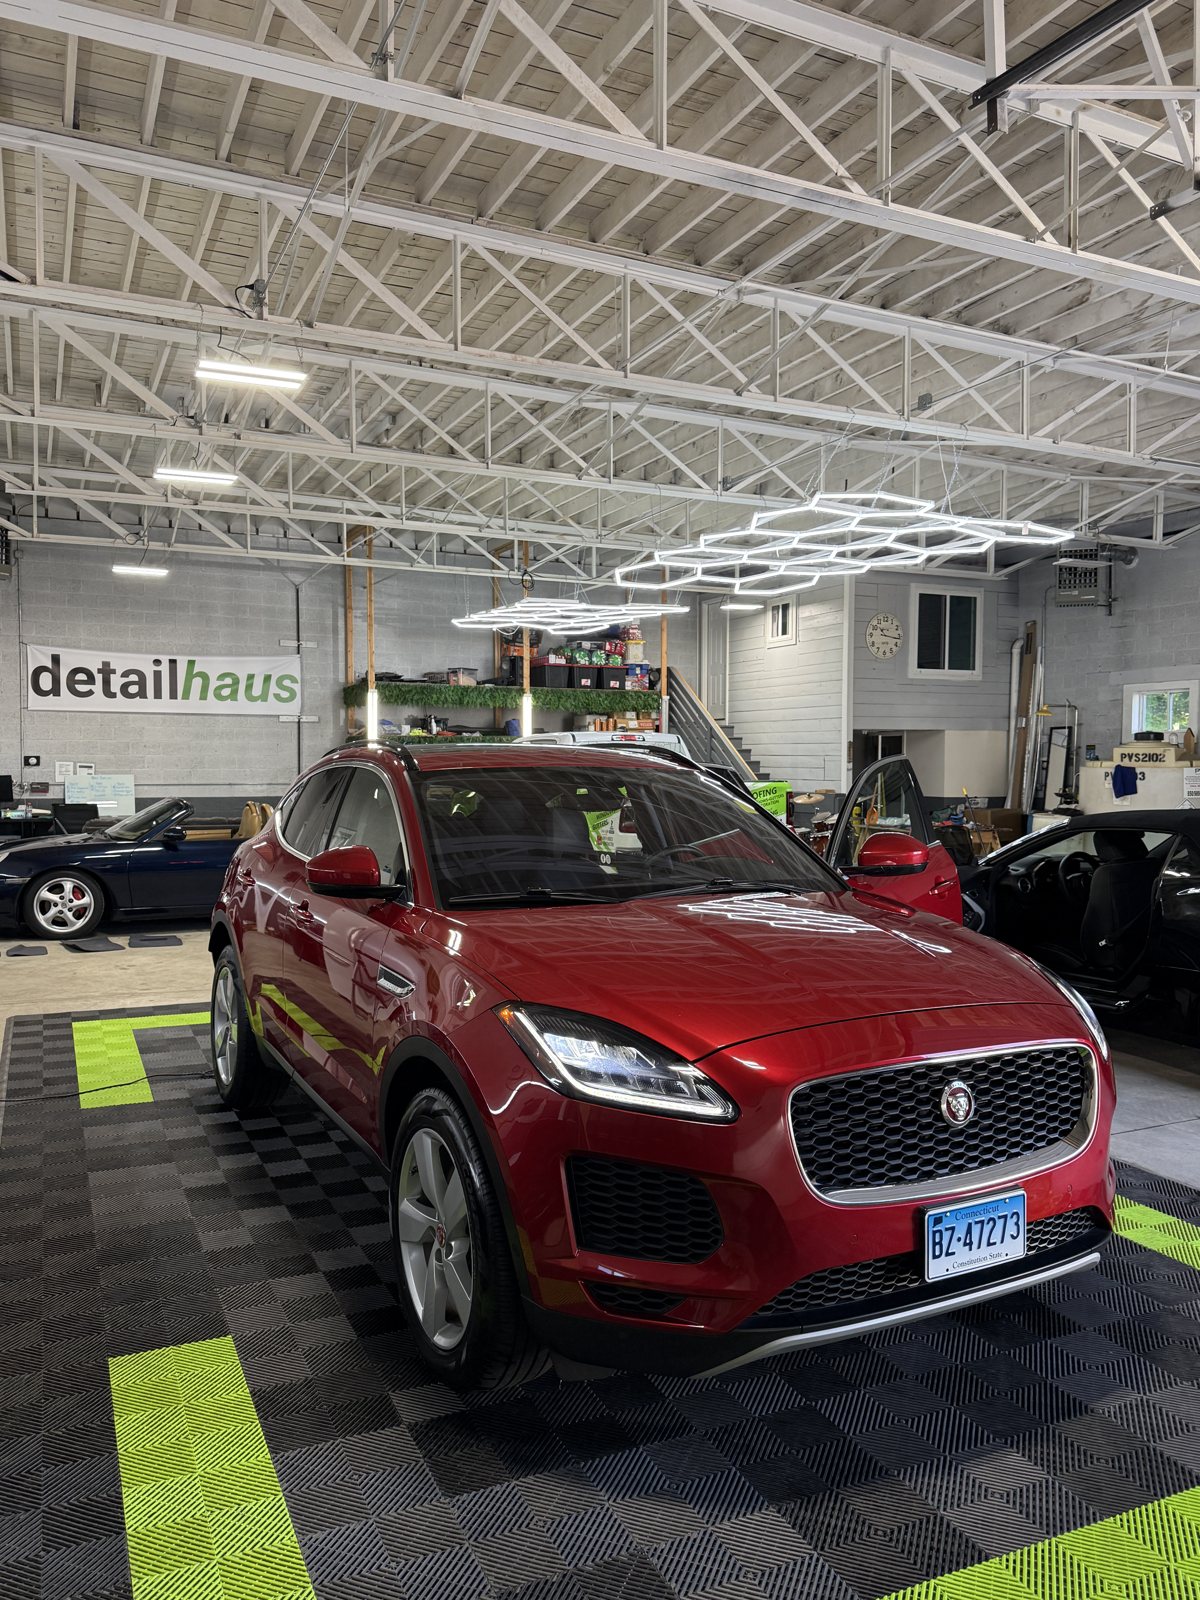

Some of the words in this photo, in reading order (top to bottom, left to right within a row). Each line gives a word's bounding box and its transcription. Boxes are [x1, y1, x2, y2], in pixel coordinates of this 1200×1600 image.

[31, 654, 299, 703] detailhaus
[1120, 753, 1166, 762] PVS2102
[752, 787, 777, 800] OFING
[955, 1204, 1000, 1221] Connecticut
[952, 1255, 988, 1270] Constitution
[988, 1251, 1003, 1262] State
